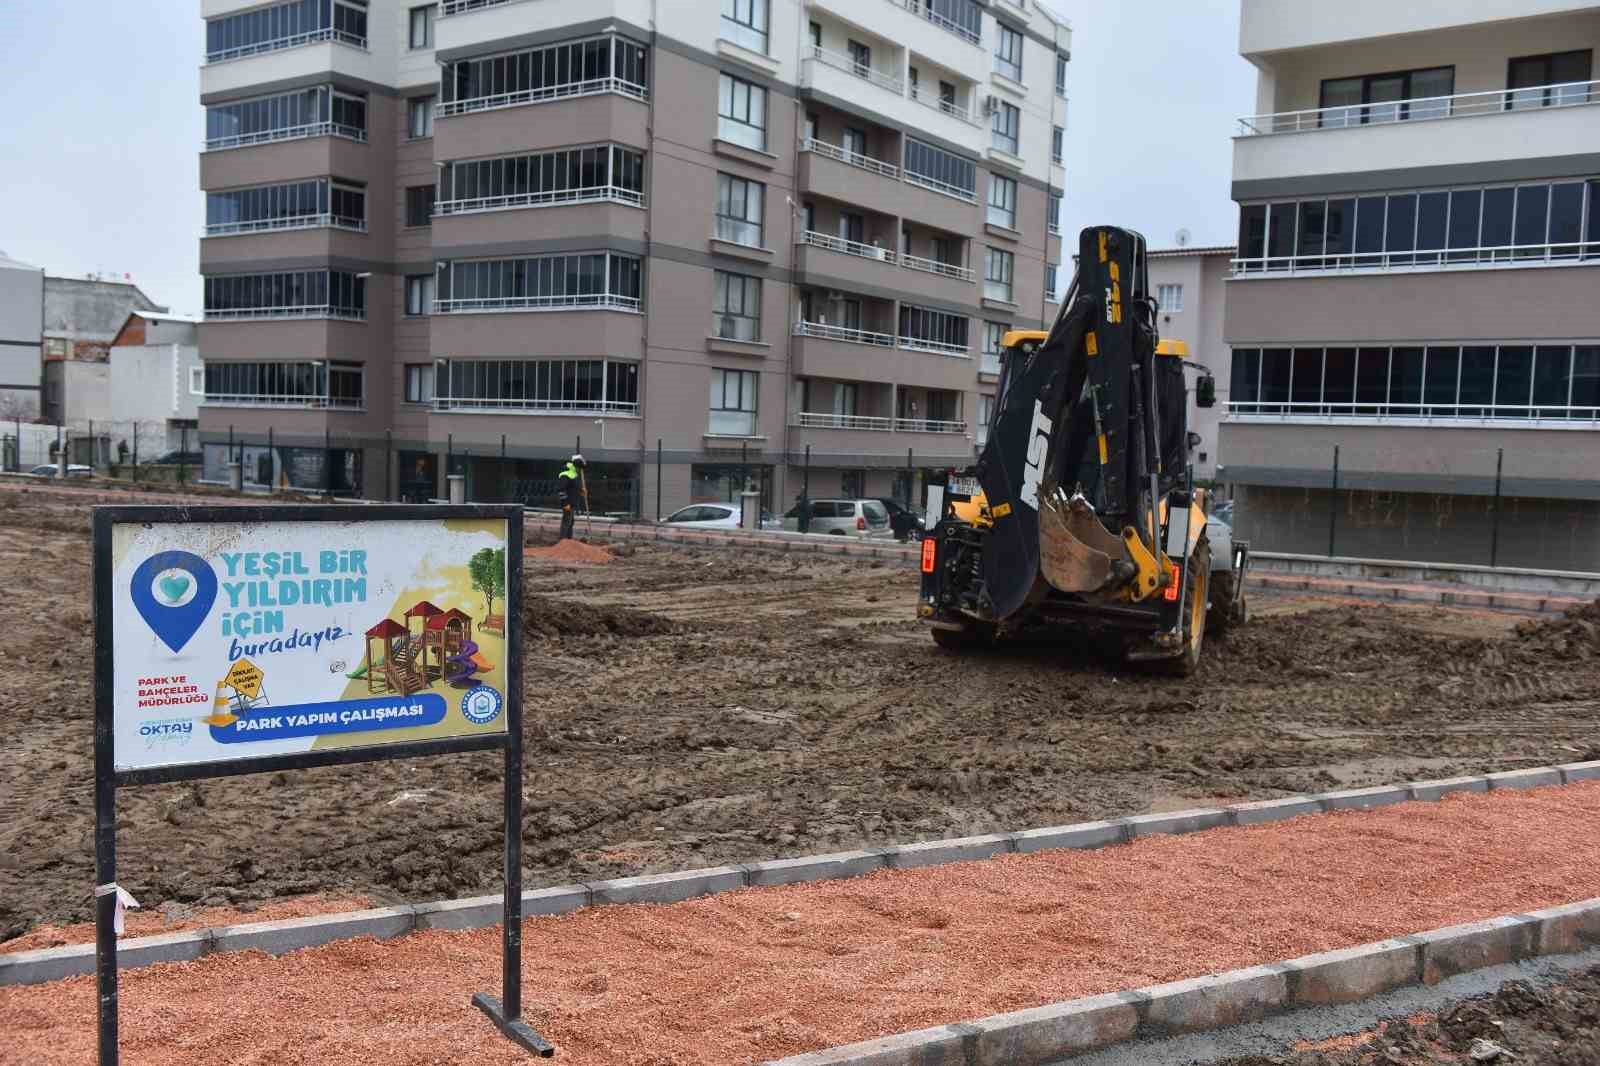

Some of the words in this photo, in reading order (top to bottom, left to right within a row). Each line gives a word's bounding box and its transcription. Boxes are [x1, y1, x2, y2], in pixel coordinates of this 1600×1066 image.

[1020, 398, 1053, 511] MST
[220, 551, 309, 580] YEŞİL
[319, 550, 367, 575] BİR
[222, 577, 367, 607] YILDIRIM
[222, 609, 284, 639] İÇİN
[229, 626, 352, 661] buradayız
[138, 676, 168, 686] PARK
[171, 675, 186, 684] VE
[138, 685, 198, 698] BAHÇELER
[138, 694, 208, 708] MÜDÜRLÜĞÜ
[140, 722, 193, 736] OKTAY
[236, 717, 283, 732] PARK
[286, 712, 338, 727] YAPIM
[340, 704, 423, 725] ÇALIŞMASI
